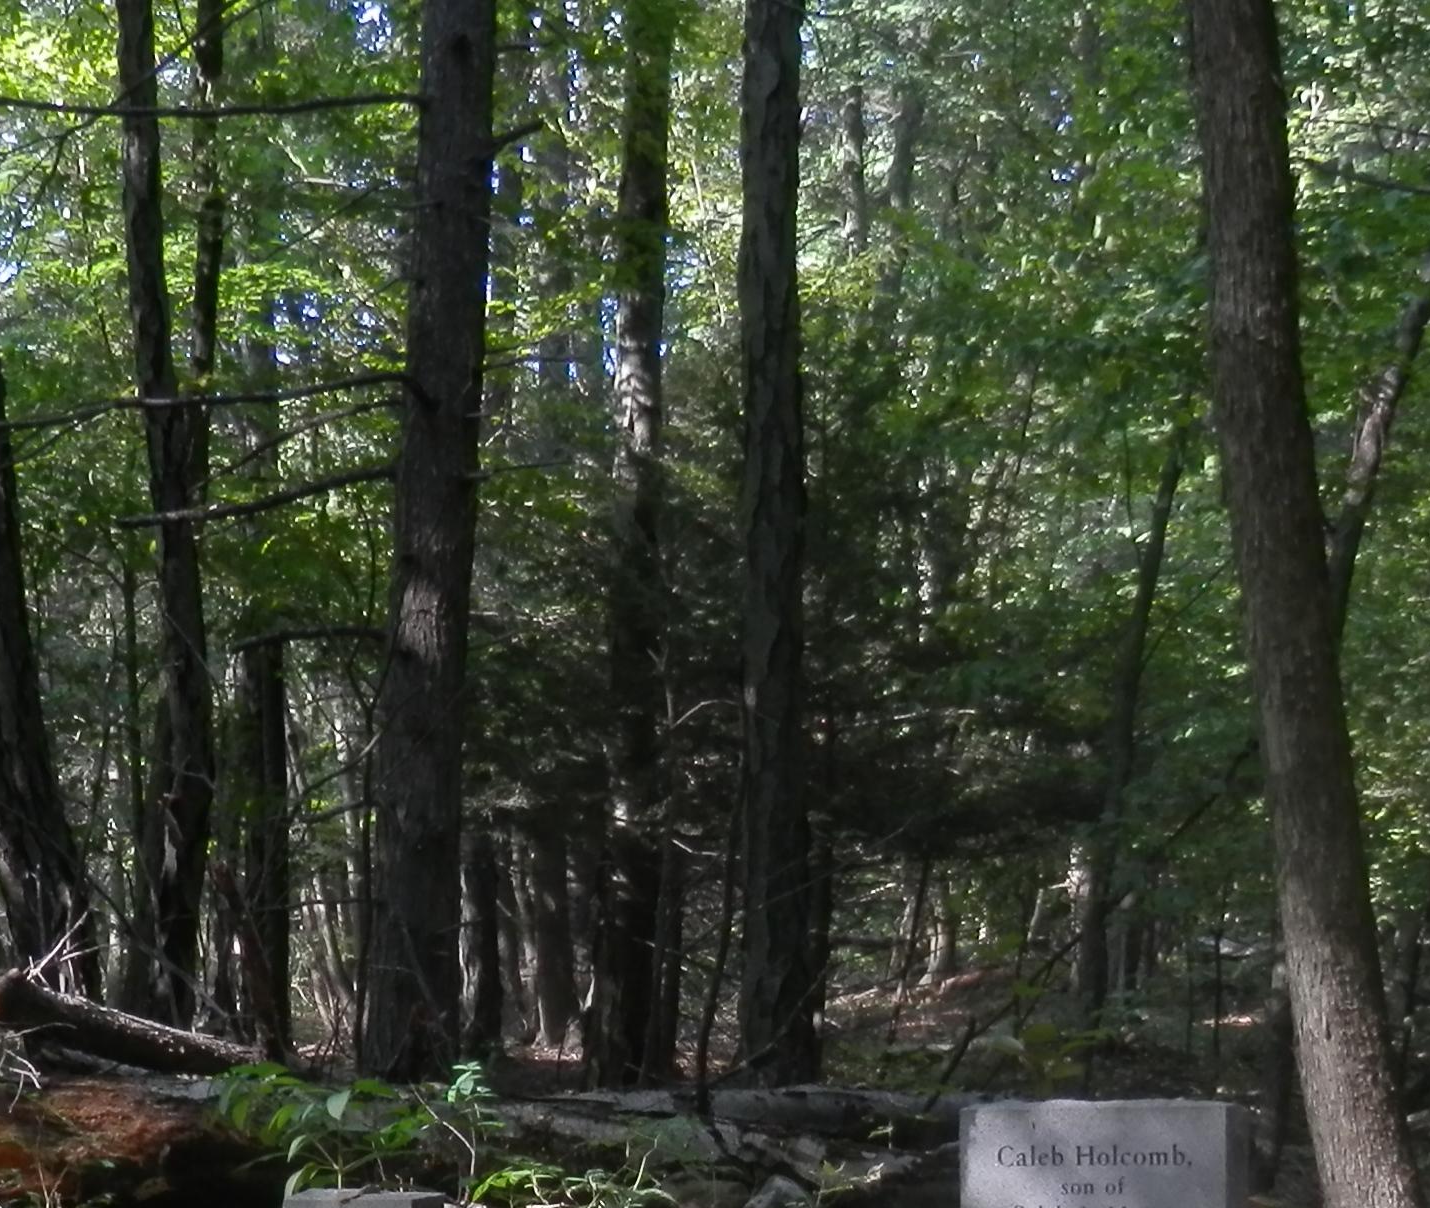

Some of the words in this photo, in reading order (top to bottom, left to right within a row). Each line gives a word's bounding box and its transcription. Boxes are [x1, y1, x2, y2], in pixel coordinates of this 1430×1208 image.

[997, 1144, 1064, 1167] Caleb
[1061, 1182, 1094, 1195] son
[1105, 1176, 1125, 1195] of
